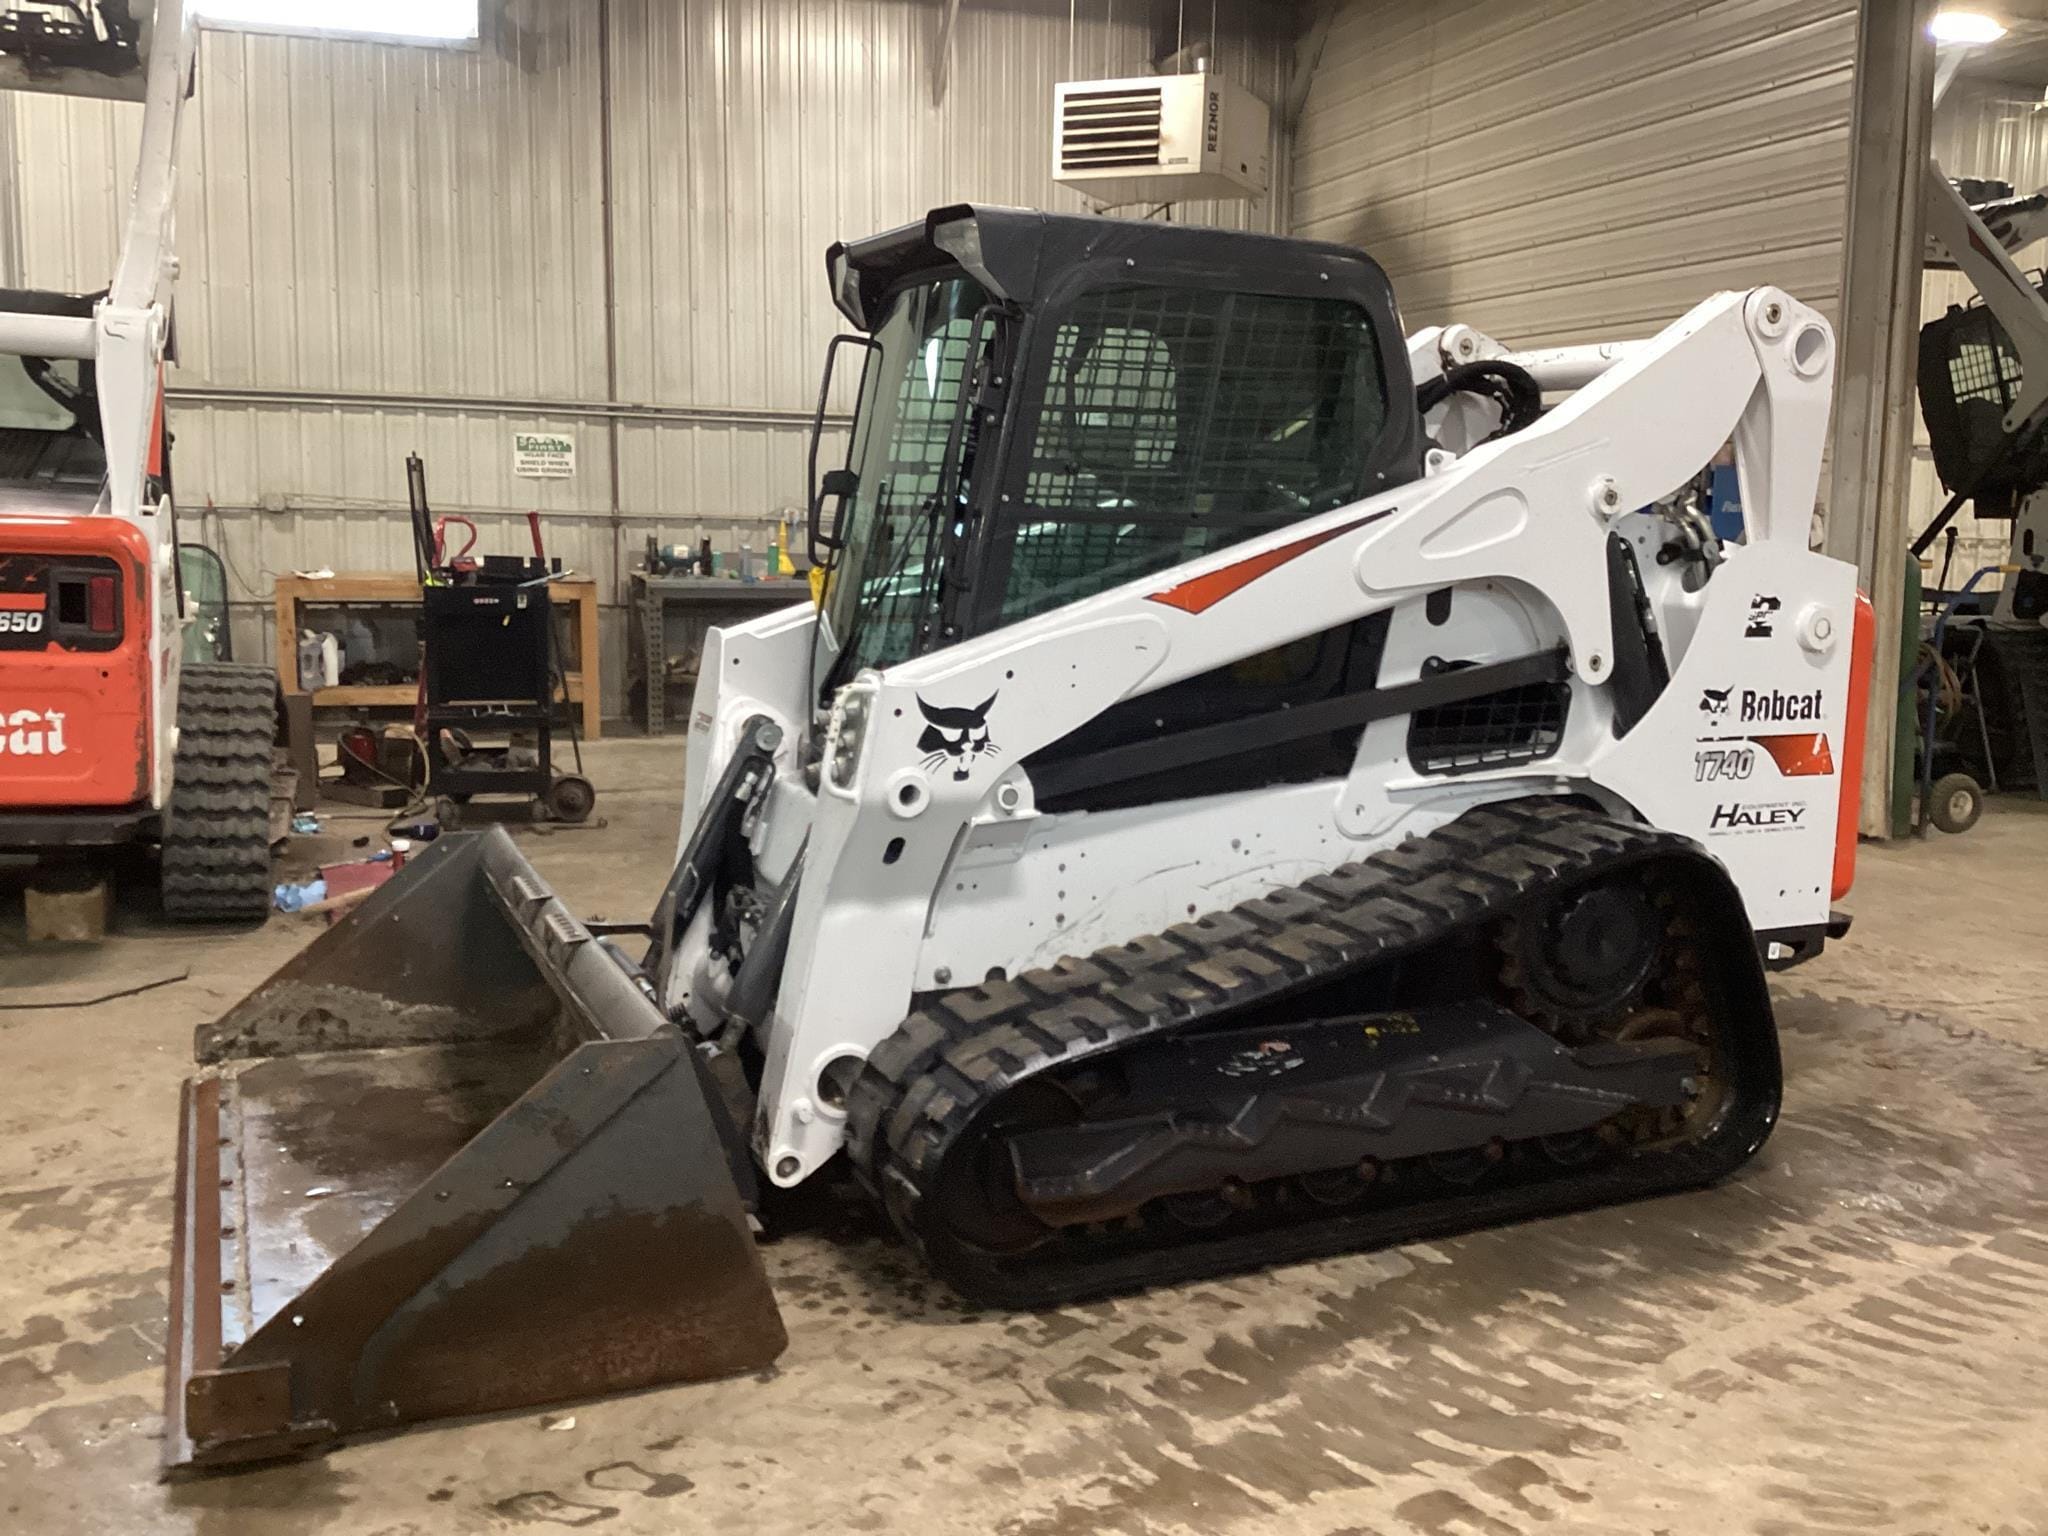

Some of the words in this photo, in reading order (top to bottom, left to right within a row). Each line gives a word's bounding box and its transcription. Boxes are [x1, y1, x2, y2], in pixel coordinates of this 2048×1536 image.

[1207, 91, 1219, 153] REZNOR
[1740, 689, 1823, 722] Bobcat
[1695, 748, 1755, 782] T740
[1710, 803, 1806, 828] HALEY
